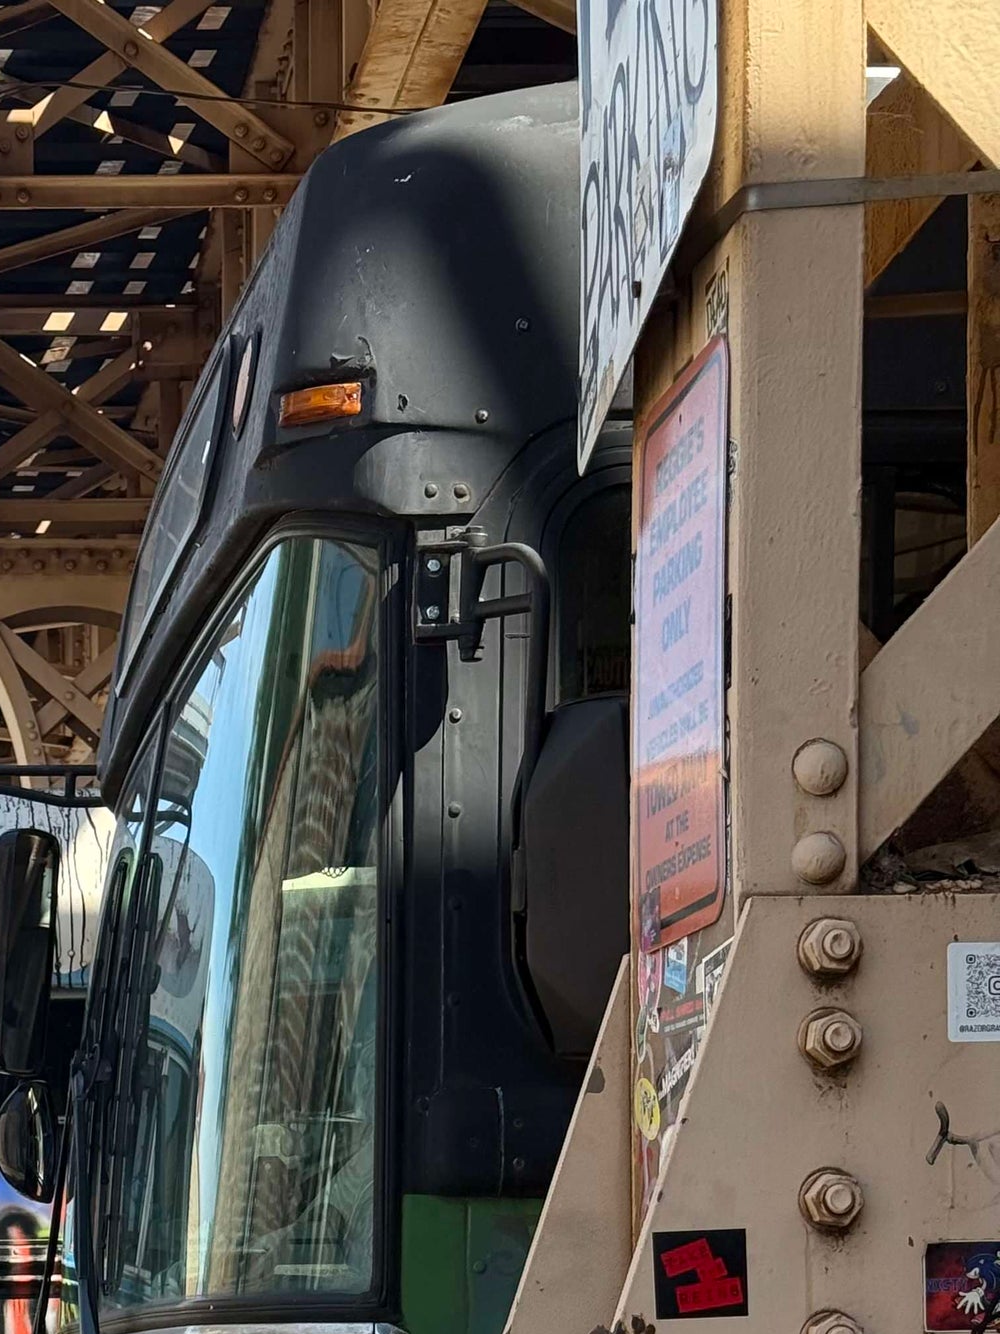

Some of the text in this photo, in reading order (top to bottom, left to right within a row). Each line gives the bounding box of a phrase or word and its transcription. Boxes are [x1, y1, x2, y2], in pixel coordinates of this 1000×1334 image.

[649, 466, 709, 557] EMPLOYEE
[652, 528, 703, 608] PARKING
[661, 594, 691, 655] ONLY
[644, 763, 679, 821] TOWED
[664, 808, 689, 844] AT THE
[678, 831, 711, 874] EXPENSE
[959, 1023, 1000, 1033] @RAZORGRA
